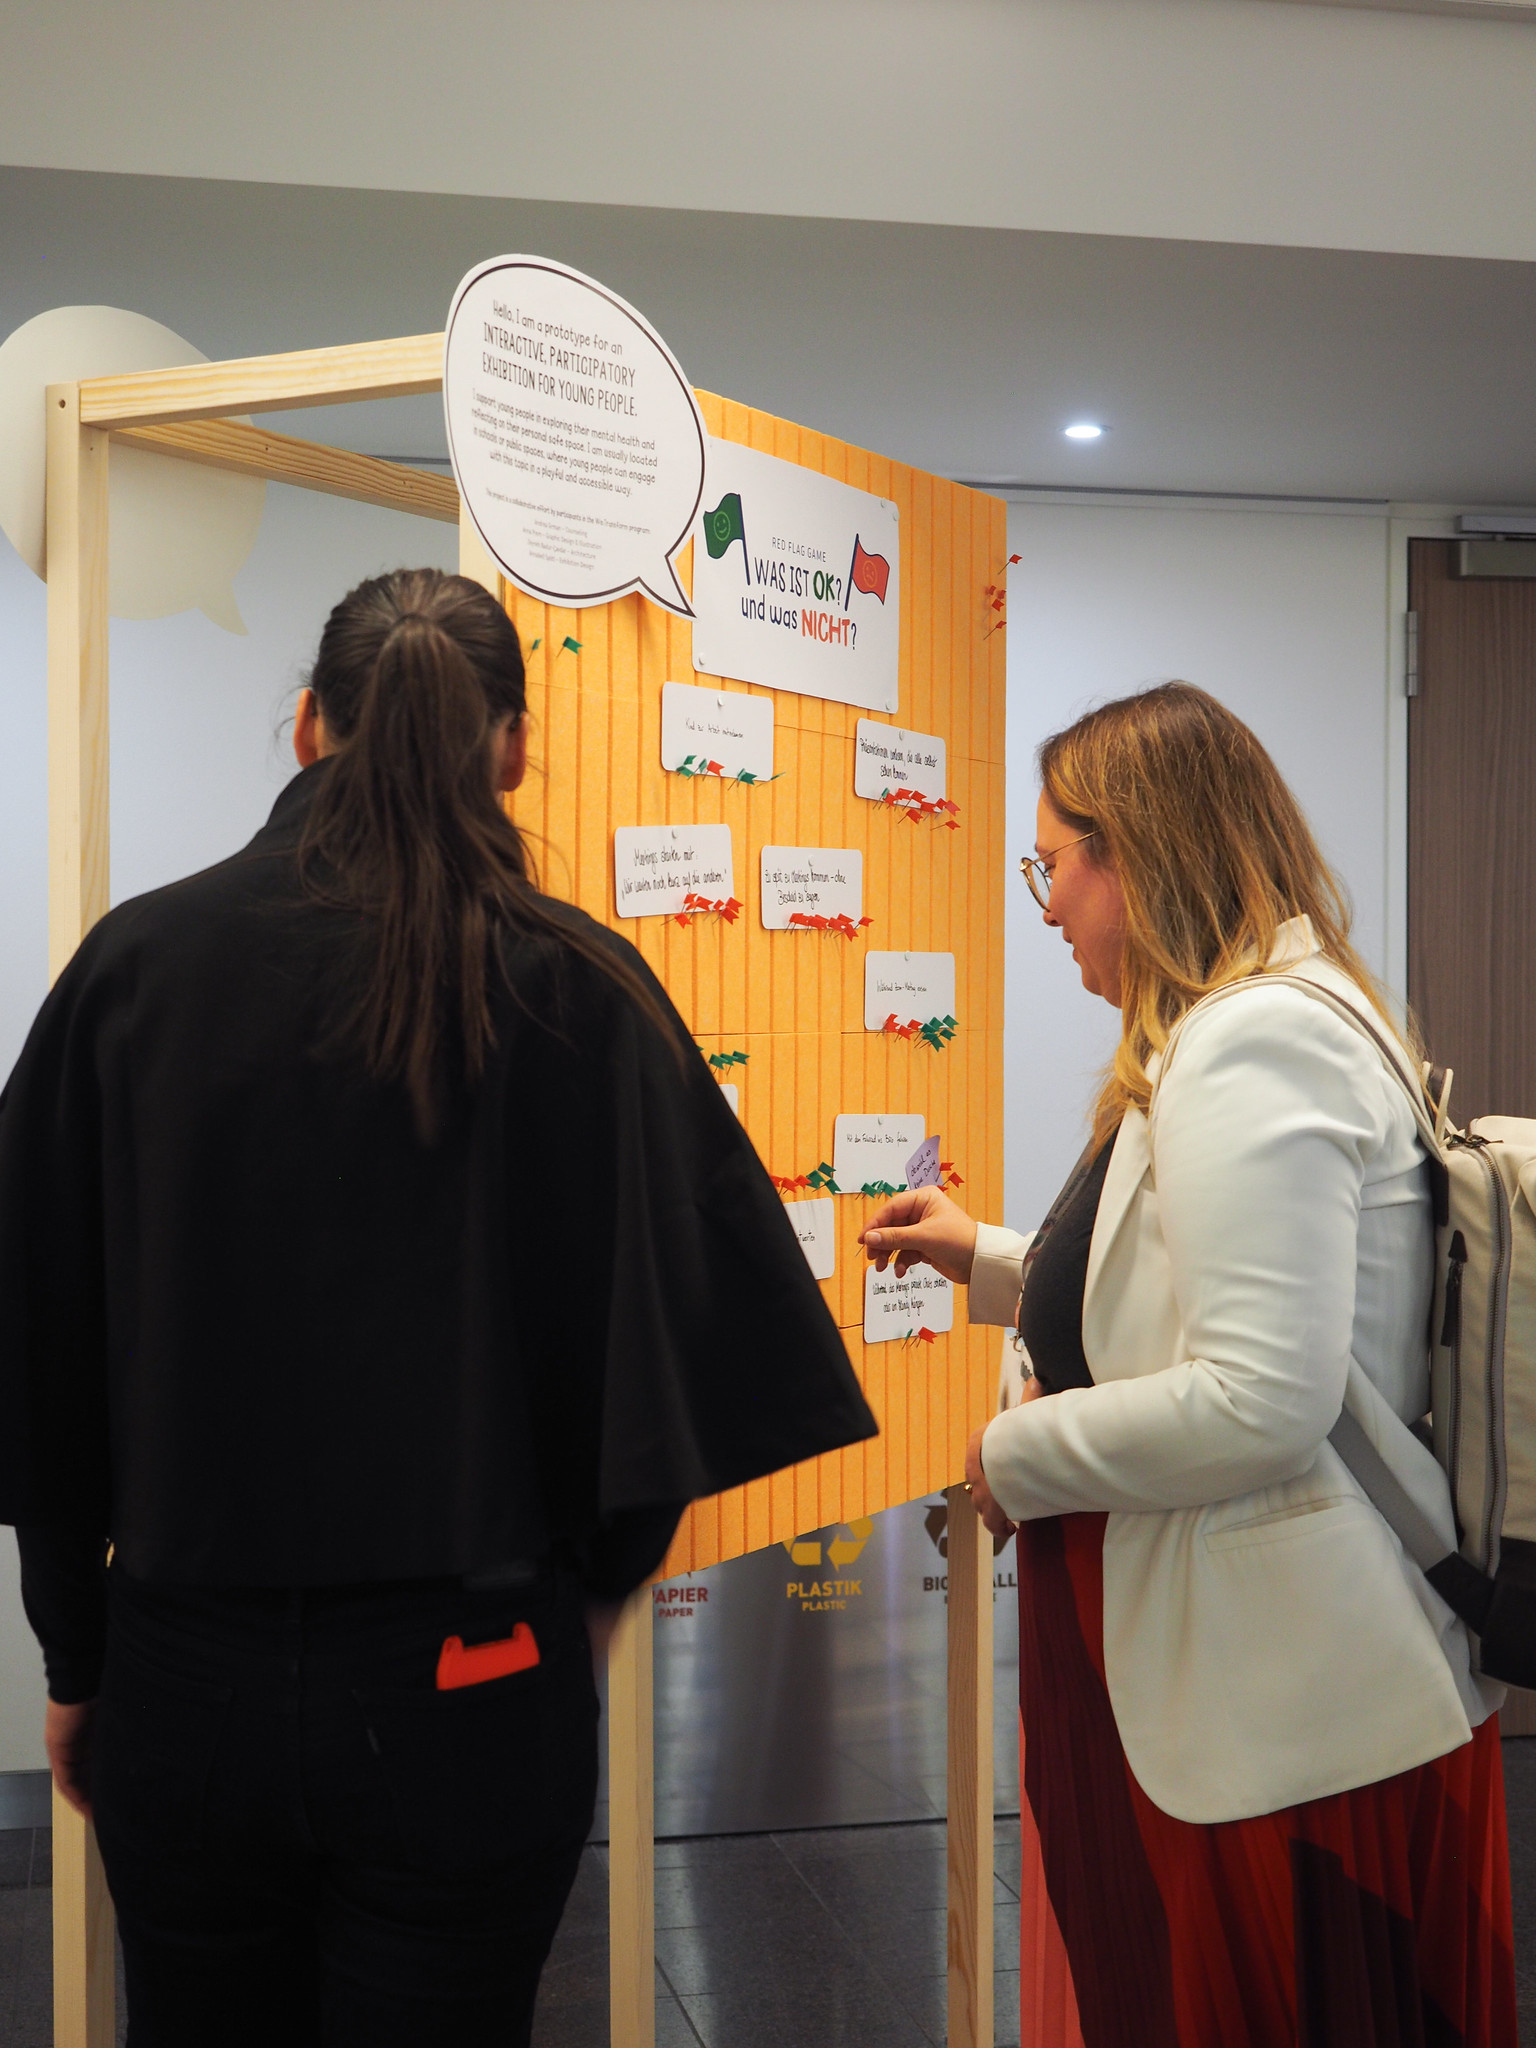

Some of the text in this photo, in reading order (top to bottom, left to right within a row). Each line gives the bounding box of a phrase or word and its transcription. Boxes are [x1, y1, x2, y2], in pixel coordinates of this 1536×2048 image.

[493, 300, 514, 323] Hello,
[522, 317, 535, 329] am
[537, 322, 542, 331] a
[545, 324, 591, 347] prototype
[593, 333, 608, 351] for
[611, 343, 622, 355] an
[484, 322, 635, 388] INTERACTIVE, PARTICIPATORY
[483, 352, 637, 416] EXHIBITION FOR YOUNG PEOPLE.
[472, 408, 497, 430] reflecting
[499, 419, 505, 428] on
[506, 421, 519, 433] their
[521, 427, 547, 442] personal
[549, 434, 563, 446] safe
[565, 439, 586, 452] space.
[591, 447, 602, 456] am
[604, 449, 628, 464] usually
[629, 451, 657, 467] located
[476, 393, 496, 408] support
[497, 402, 514, 418] young
[515, 408, 535, 421] people
[543, 416, 572, 435] exploring
[573, 422, 590, 436] their
[591, 429, 615, 443] mental
[616, 432, 640, 447] health
[641, 440, 655, 450] and
[478, 427, 497, 443] schools
[499, 437, 505, 445] or
[506, 437, 522, 452] public
[523, 445, 546, 459] spaces,
[547, 451, 568, 464] where
[569, 458, 589, 472] young
[590, 463, 613, 476] people
[614, 468, 627, 477] can
[629, 471, 656, 486] engage
[490, 450, 501, 461] with
[503, 453, 513, 466] this
[514, 458, 529, 472] topic
[542, 466, 564, 481] playful
[565, 473, 578, 483] and
[578, 477, 613, 491] accessible
[615, 485, 632, 498] way.
[772, 537, 827, 563] RED FLAG GAME
[754, 557, 842, 606] WAS IST OK?
[741, 593, 857, 651] und was NICHT?
[634, 847, 658, 874] Meetings
[683, 872, 692, 894] auf
[692, 870, 700, 885] die
[658, 1608, 693, 1618] PAPER
[786, 1580, 862, 1598] PLASTIK
[802, 1601, 847, 1611] PLASTIC
